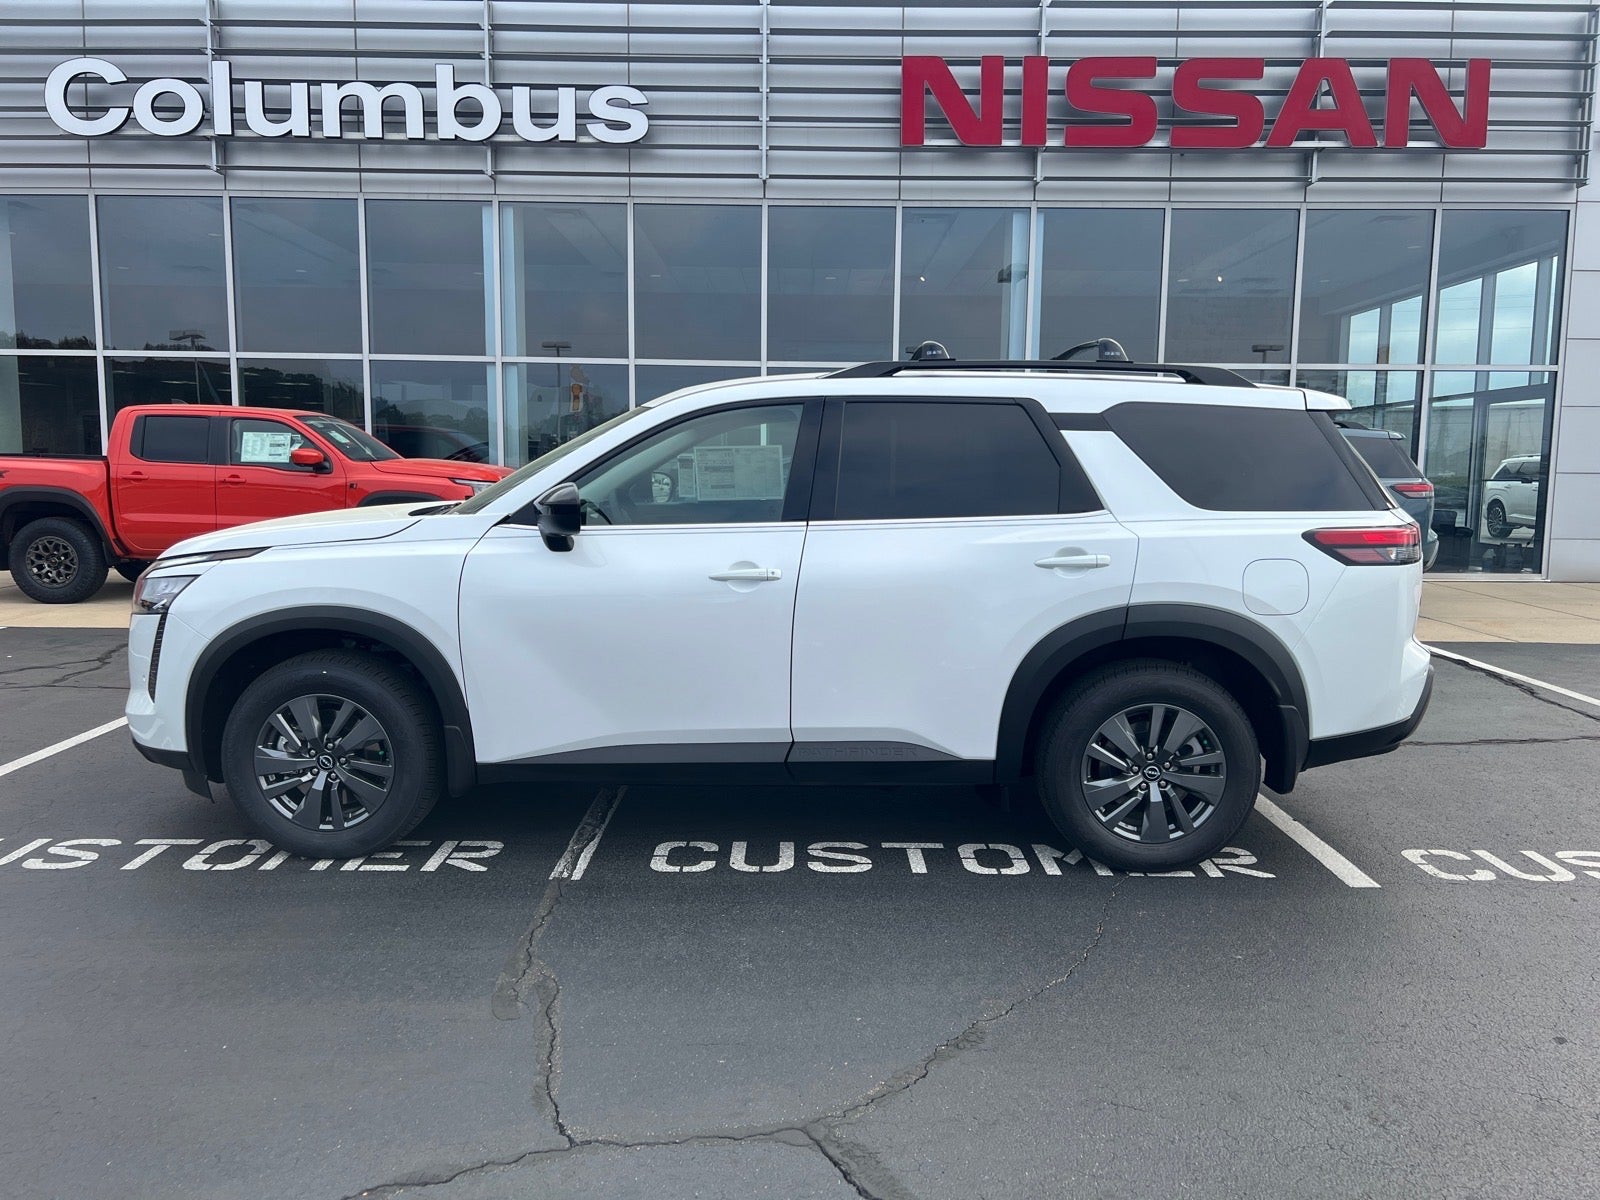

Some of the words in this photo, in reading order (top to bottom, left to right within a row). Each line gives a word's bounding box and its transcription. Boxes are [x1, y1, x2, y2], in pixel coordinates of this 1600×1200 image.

[44, 56, 650, 144] Columbus
[900, 55, 1492, 149] NISSAN
[649, 841, 1277, 878] CUSTOMR
